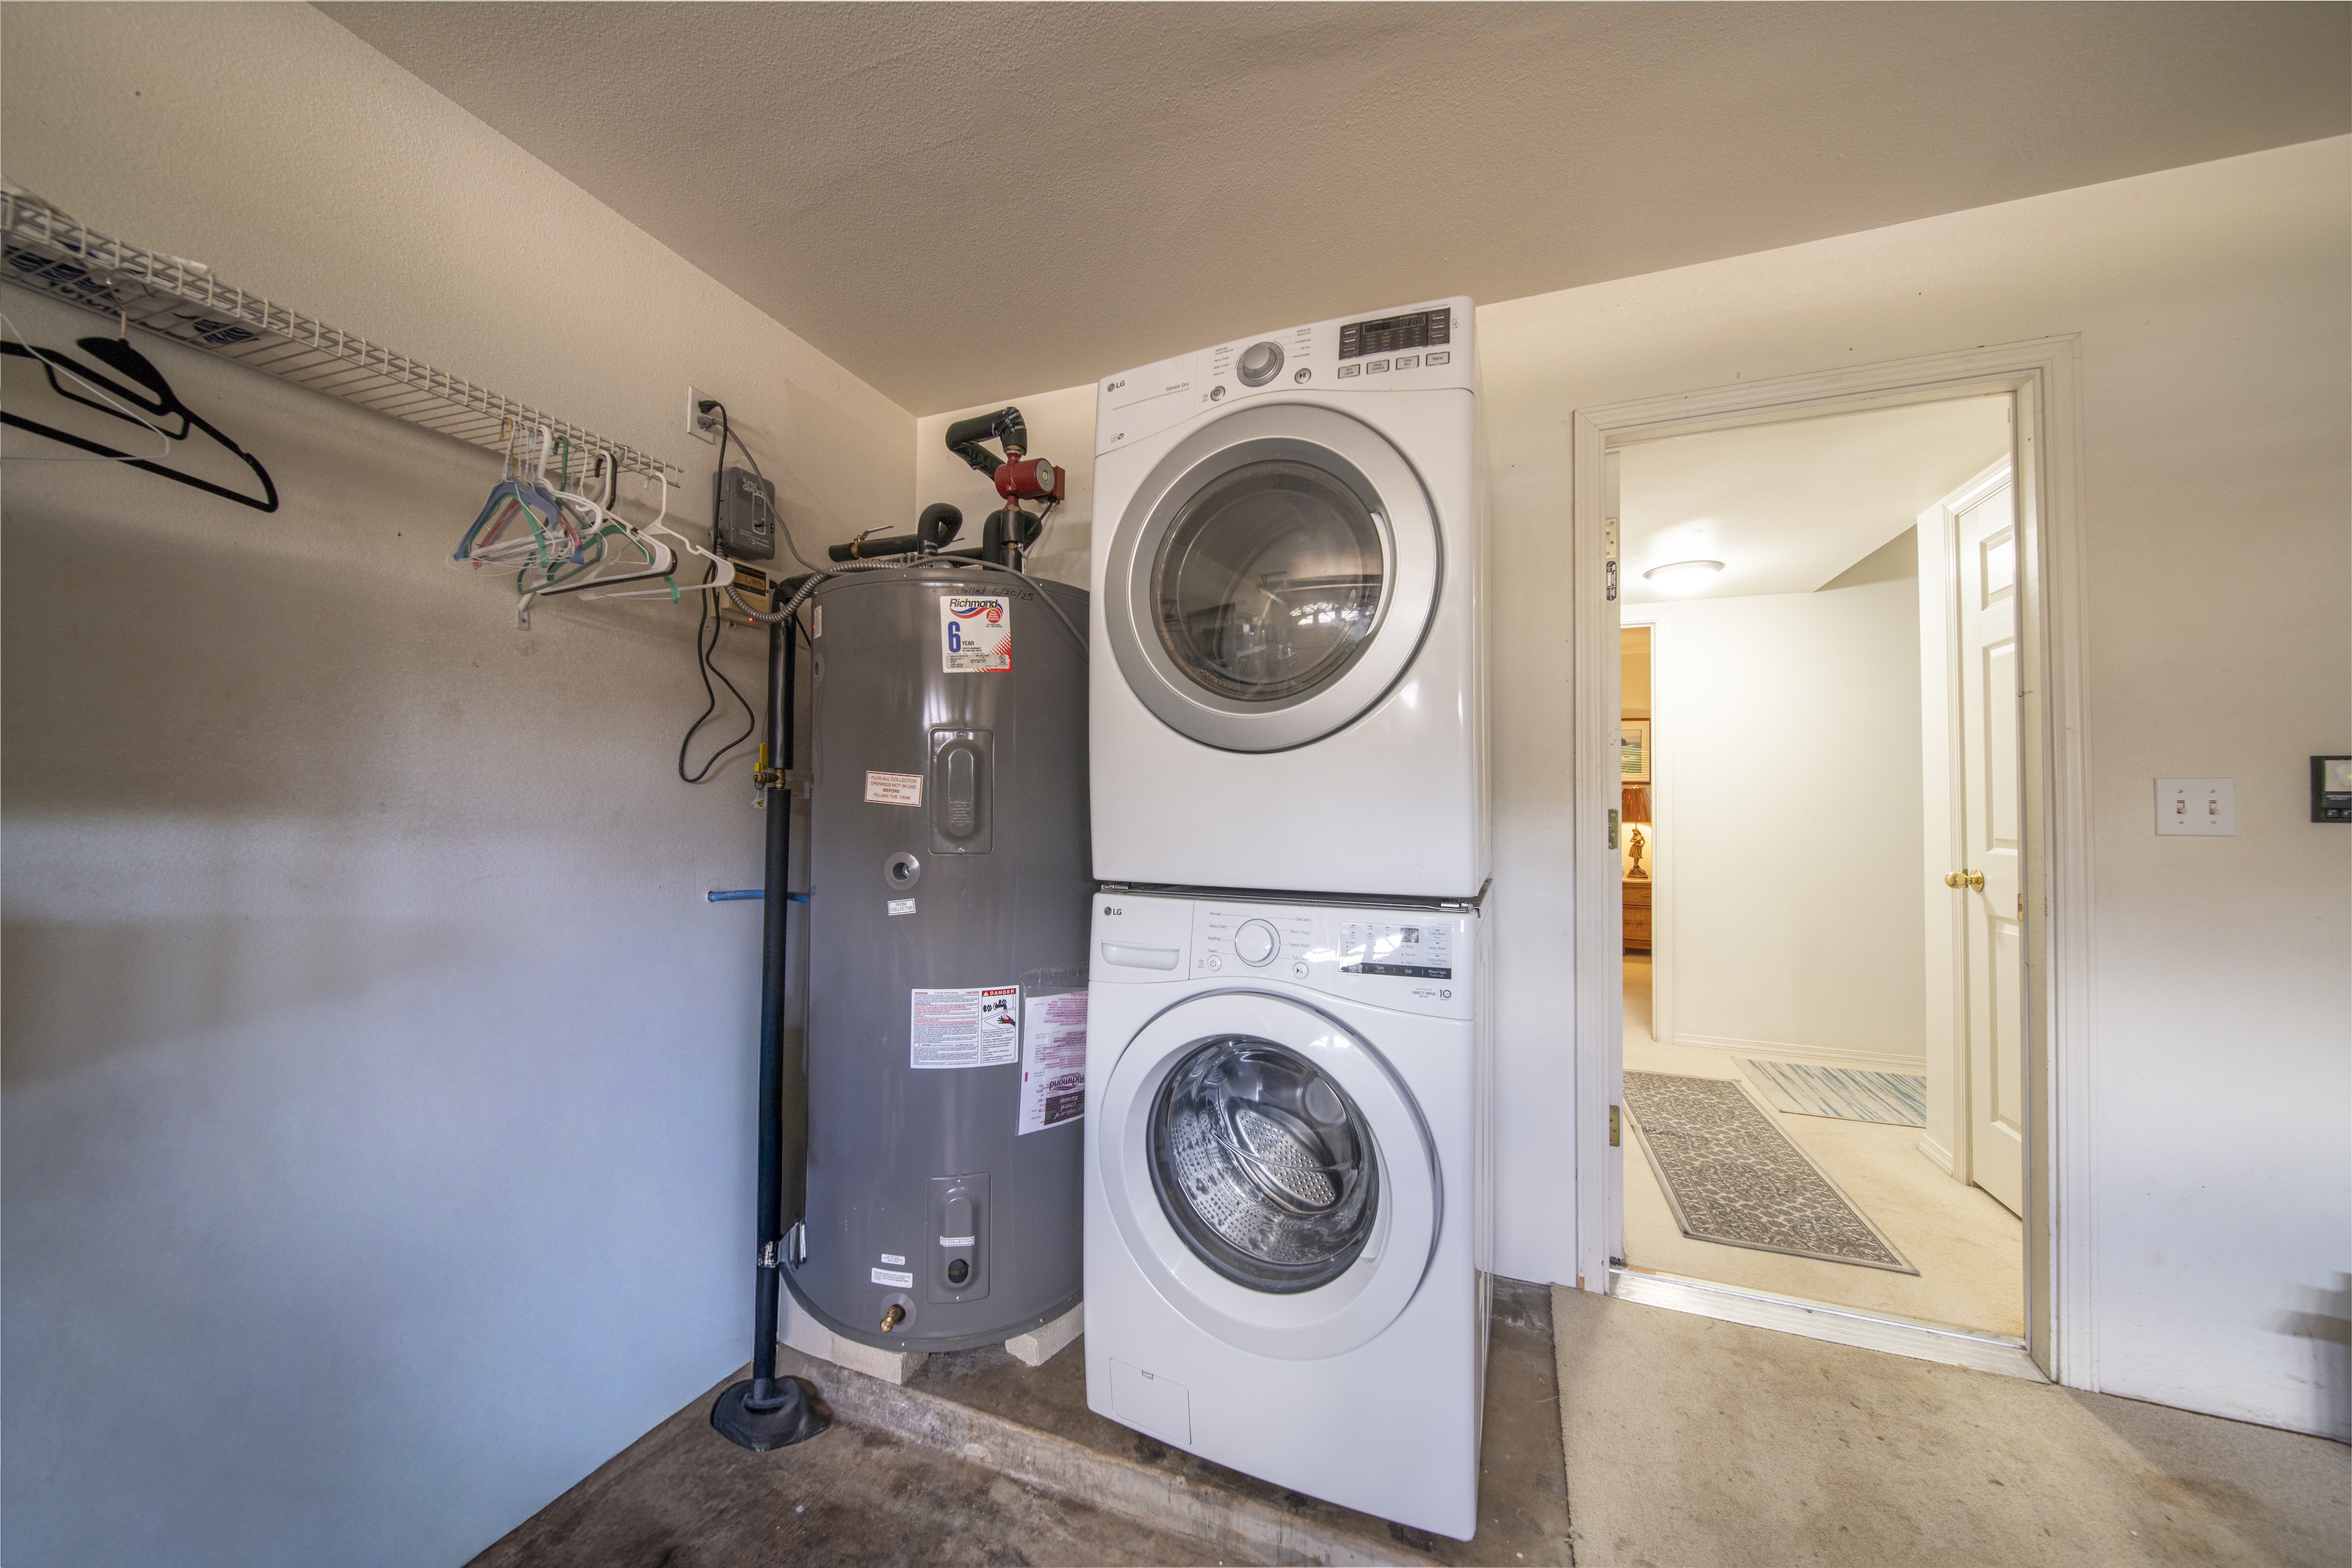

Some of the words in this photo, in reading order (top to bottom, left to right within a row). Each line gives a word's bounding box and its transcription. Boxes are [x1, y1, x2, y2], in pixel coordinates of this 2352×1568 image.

[743, 485, 755, 493] GRAY
[992, 588, 1034, 601] 6/20/25
[950, 599, 998, 608] Richmond
[948, 621, 961, 653] 6
[1440, 989, 1451, 998] 10
[1049, 1075, 1084, 1091] Richmond
